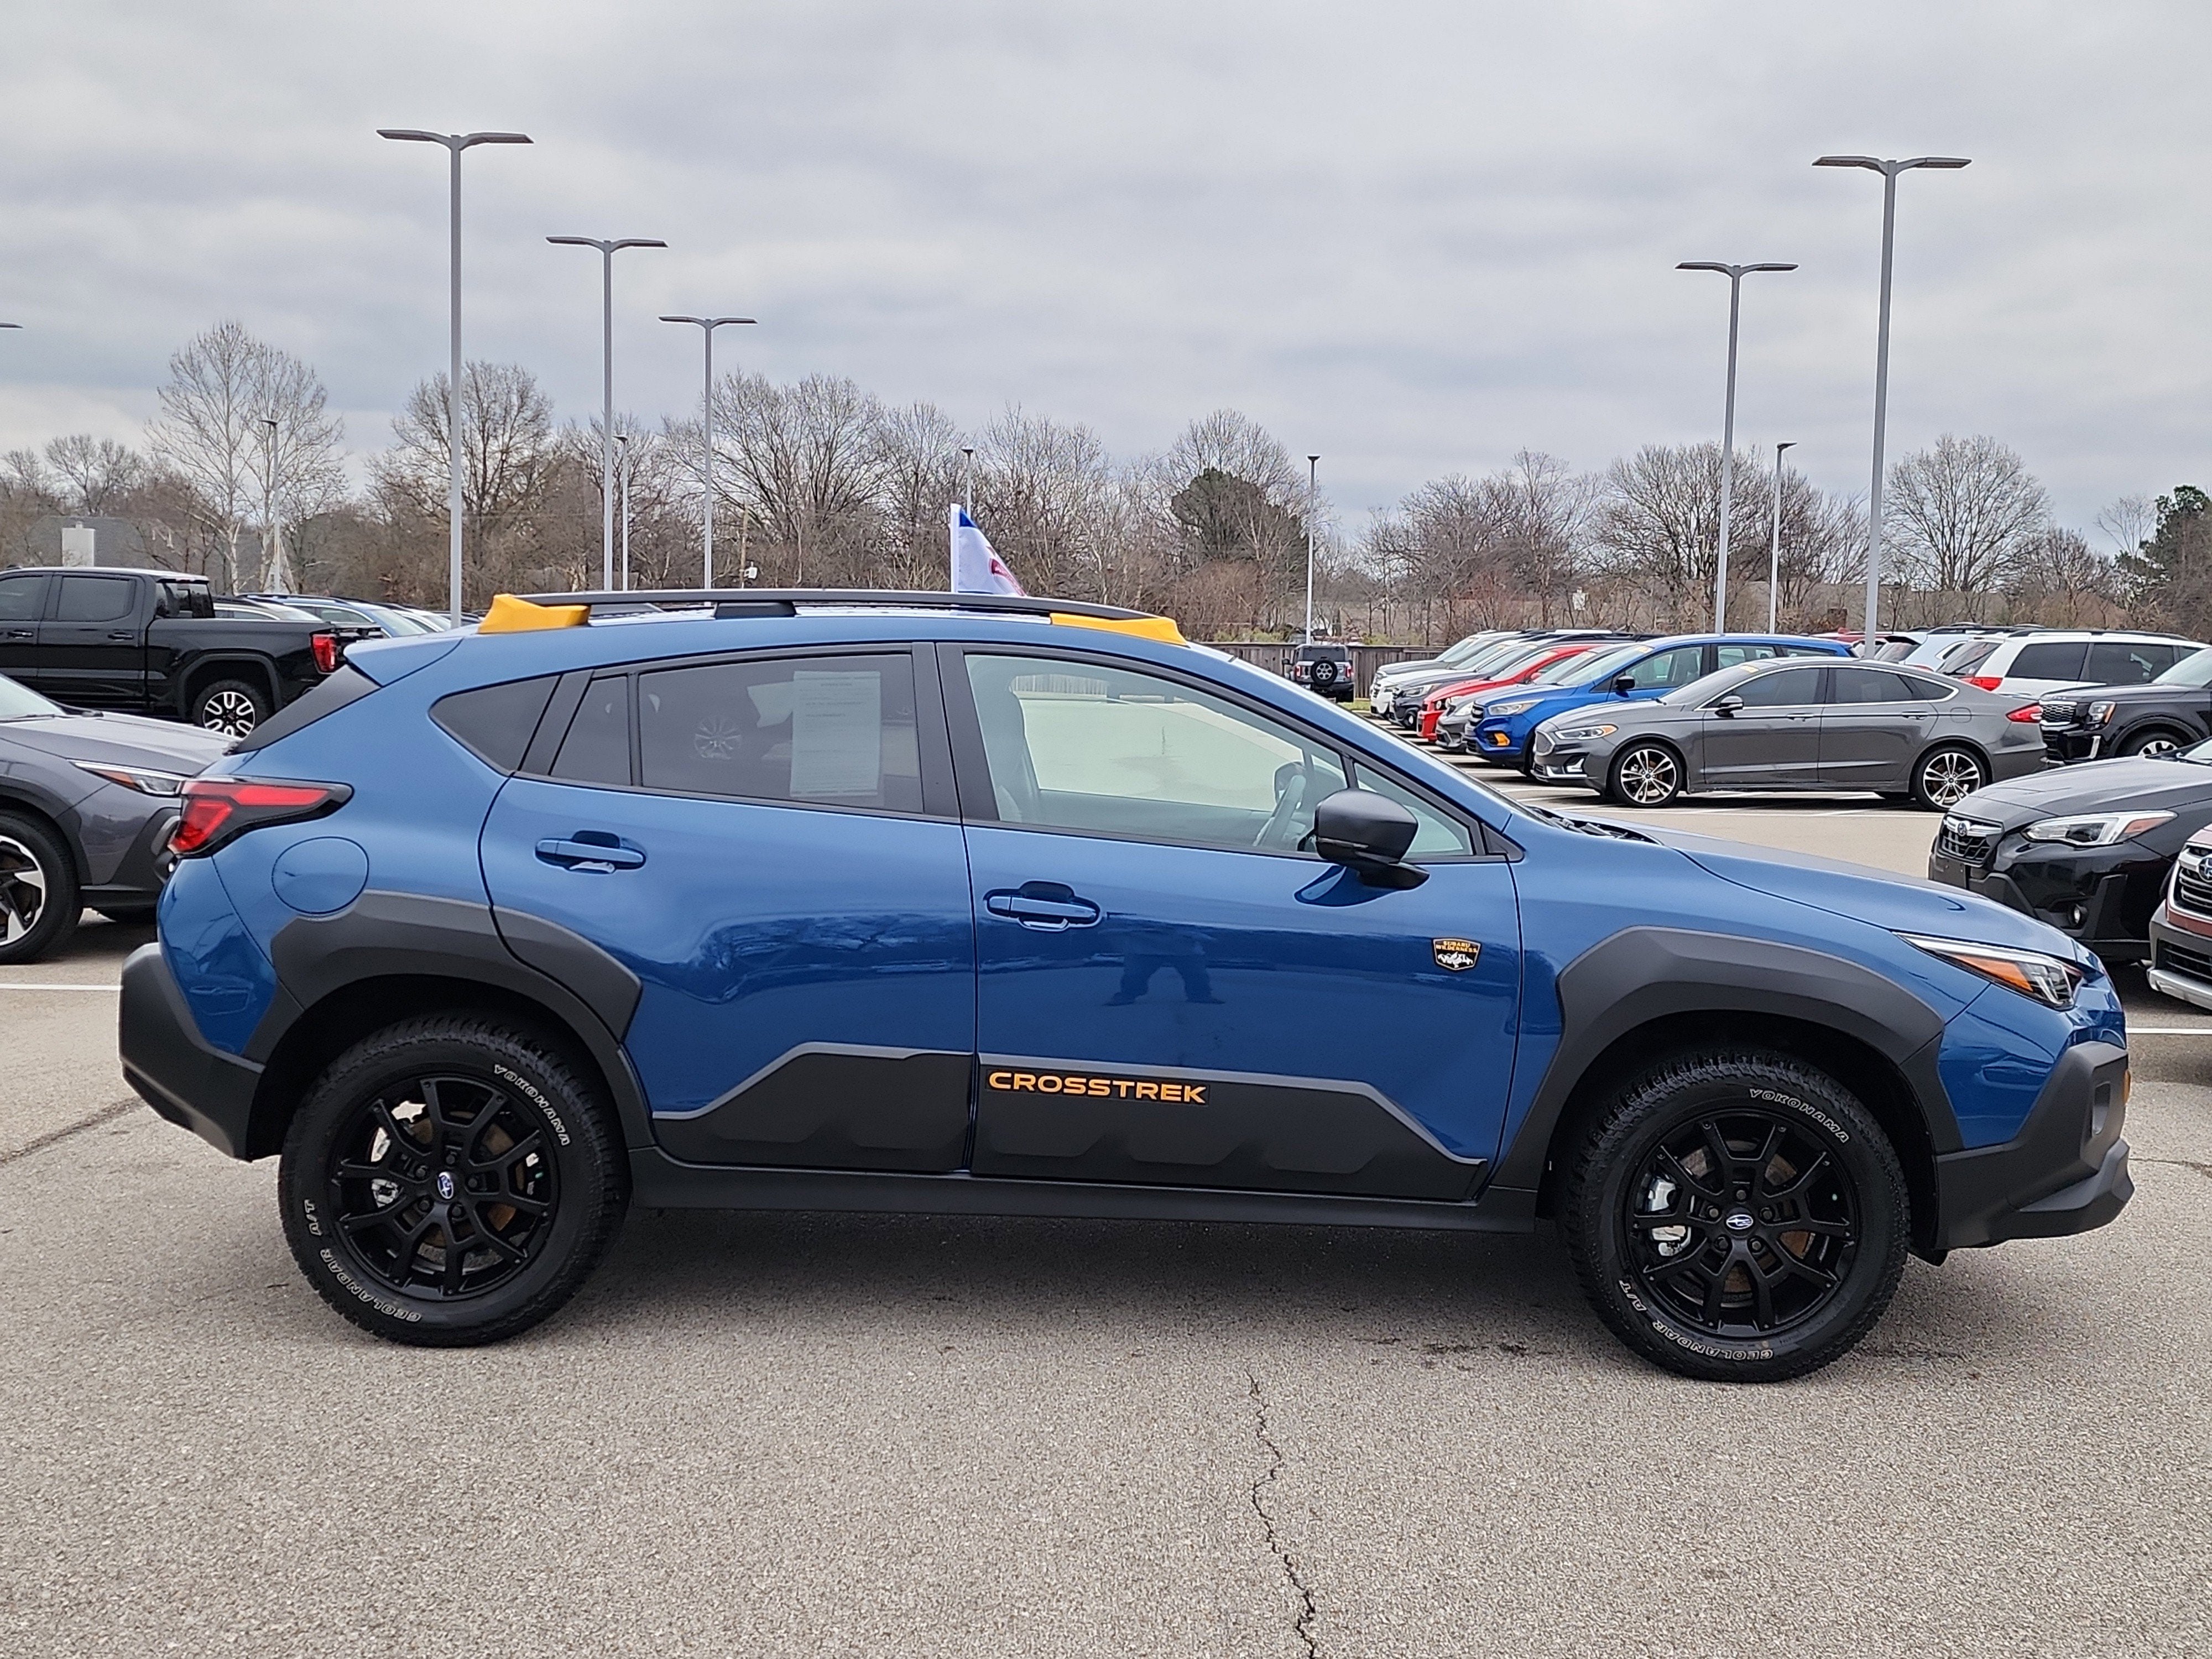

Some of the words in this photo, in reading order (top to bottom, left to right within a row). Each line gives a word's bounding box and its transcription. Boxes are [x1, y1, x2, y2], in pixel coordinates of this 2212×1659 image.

[494, 1063, 571, 1146] YOKOHAMA
[989, 1072, 1206, 1104] CROSSTREK
[1749, 1088, 1849, 1143] YOKOHAMA
[304, 1199, 322, 1236] A/T
[320, 1248, 422, 1322] GEOLANDAR
[1619, 1280, 1647, 1312] A/T
[1652, 1319, 1773, 1360] GEOLANDAR
